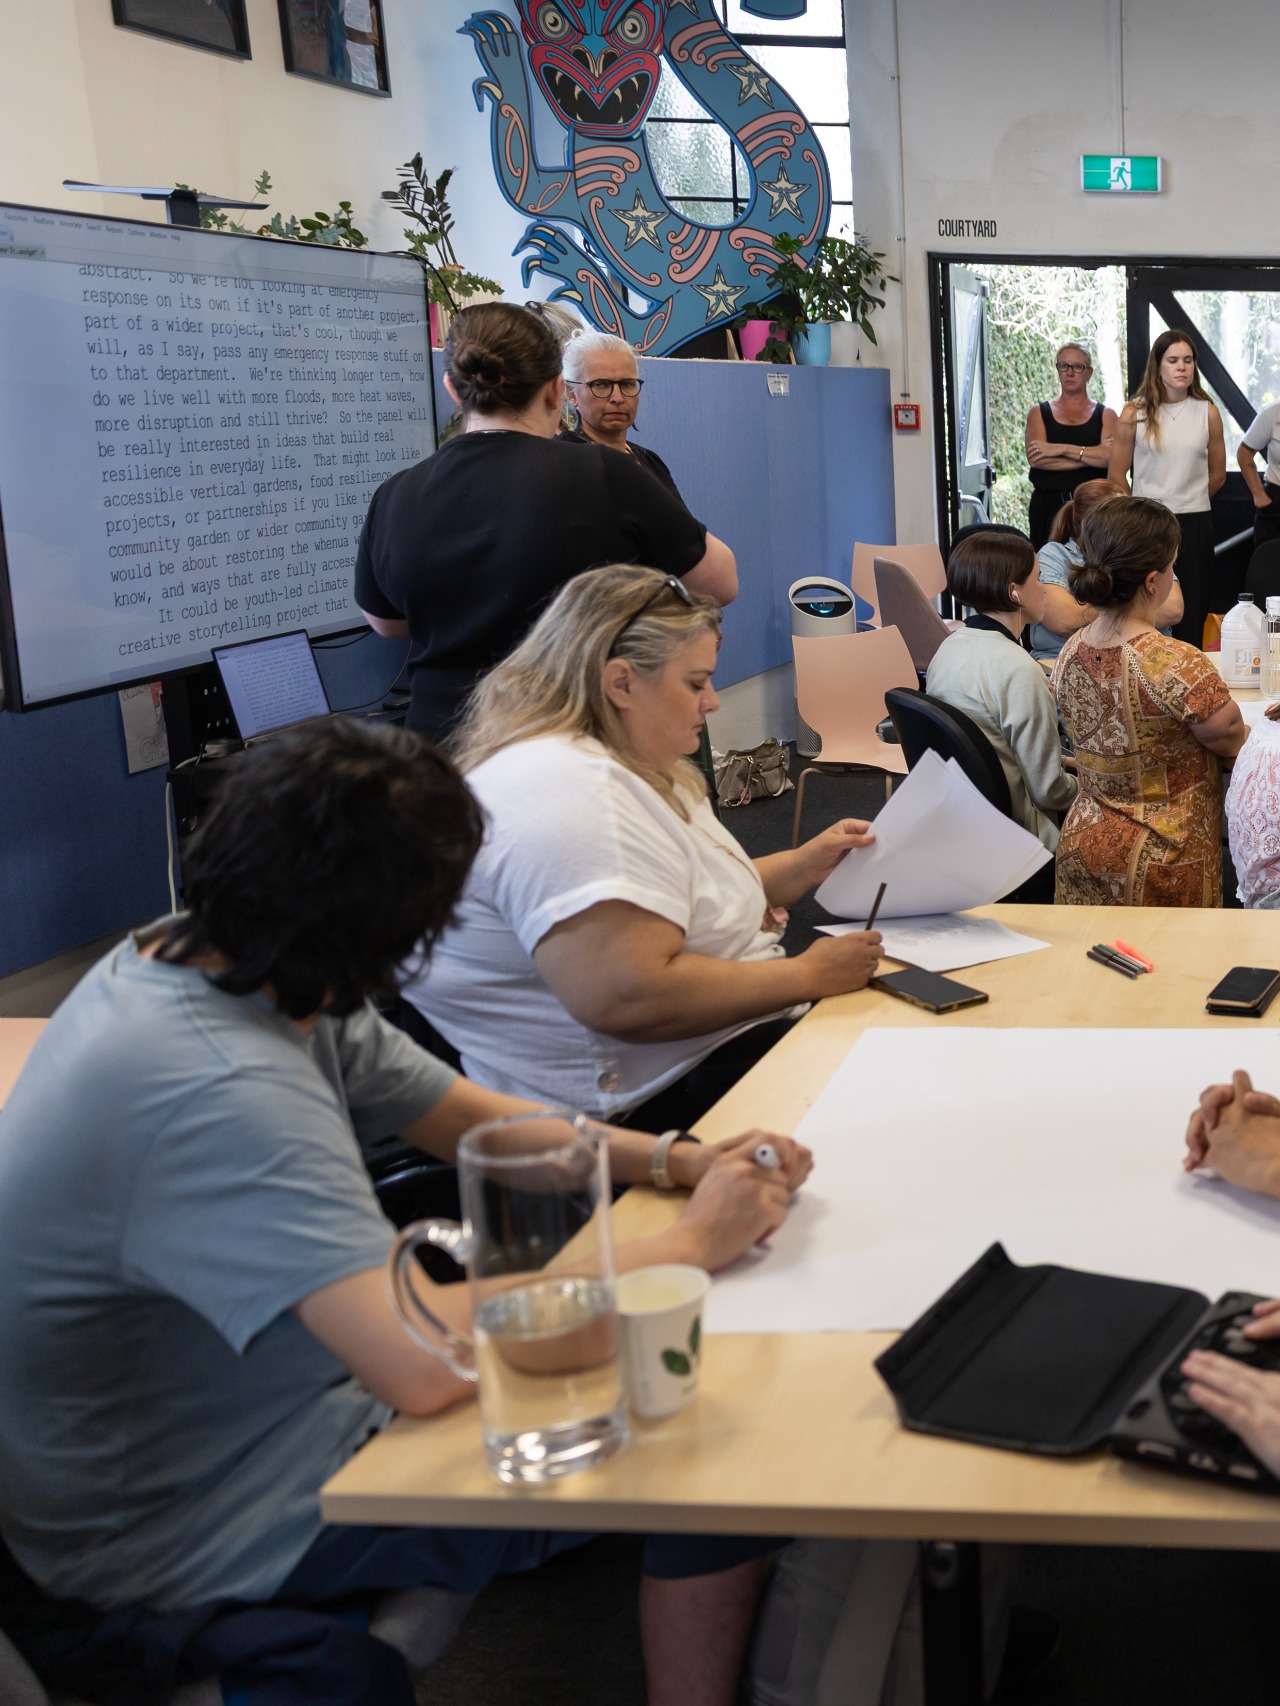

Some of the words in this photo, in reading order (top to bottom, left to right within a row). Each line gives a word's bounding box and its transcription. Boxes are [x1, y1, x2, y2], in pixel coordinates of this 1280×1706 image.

[938, 219, 996, 238] COURTYARD
[82, 290, 148, 307] response
[156, 295, 172, 307] on
[180, 292, 201, 310] its
[208, 298, 230, 311] own
[237, 296, 250, 312] if
[257, 298, 282, 314] it's
[288, 304, 314, 318] part
[318, 304, 330, 318] of
[336, 306, 374, 320] another
[380, 310, 419, 325] project,
[84, 314, 119, 332] part
[126, 314, 142, 330] of
[151, 319, 159, 331] a
[166, 317, 203, 333] wider
[211, 320, 264, 338] project,
[272, 322, 309, 338] that's
[315, 322, 342, 341] cool,
[349, 327, 382, 344] though
[386, 332, 397, 342] we
[87, 338, 127, 358] will,
[138, 343, 154, 356] as
[161, 341, 169, 356] I
[177, 345, 204, 360] say,
[213, 346, 241, 361] pass
[248, 347, 267, 362] any
[274, 348, 328, 363] emergency
[335, 350, 378, 363] response
[383, 349, 408, 362] stuff
[412, 352, 424, 362] on
[90, 365, 108, 380] to
[116, 364, 148, 380] that
[156, 365, 234, 384] department.
[249, 366, 282, 381] We're
[288, 367, 336, 384] thinking
[342, 368, 374, 384] longer
[379, 370, 404, 383] term,
[408, 368, 424, 381] how
[92, 390, 110, 406] do
[118, 394, 135, 406] we
[144, 389, 174, 406] live
[181, 389, 211, 405] well
[218, 389, 246, 404] with
[252, 392, 278, 404] more
[285, 389, 325, 404] floods,
[332, 392, 355, 402] more
[359, 389, 382, 402] heat
[386, 391, 415, 403] waves,
[95, 419, 129, 432] more
[137, 414, 213, 432] disruption
[220, 412, 241, 428] and
[248, 411, 280, 426] still
[286, 410, 328, 425] thrive?
[339, 410, 351, 424] So
[356, 409, 373, 422] the
[377, 408, 403, 425] panel
[407, 408, 427, 420] will
[98, 442, 115, 457] be
[124, 439, 171, 458] really
[180, 435, 250, 452] interested
[257, 434, 270, 449] in
[276, 433, 306, 448] ideas
[312, 432, 336, 446] that
[340, 430, 369, 444] build
[374, 428, 394, 442] real
[102, 464, 181, 482] resilience
[189, 460, 204, 476] in
[210, 453, 264, 476] everyday
[272, 455, 301, 470] life.
[313, 453, 337, 466] That
[342, 450, 370, 467] might
[375, 448, 396, 462] look
[401, 446, 420, 460] like
[104, 487, 183, 507] accessible
[190, 480, 246, 499] vertical
[253, 478, 302, 497] gardens,
[310, 473, 333, 488] food
[106, 514, 175, 536] projects,
[185, 511, 200, 524] or
[207, 500, 287, 525] partnerships
[294, 496, 305, 511] if
[311, 498, 329, 512] you
[335, 492, 357, 506] like
[108, 536, 180, 558] community
[187, 530, 230, 551] garden
[236, 529, 250, 541] or
[256, 522, 288, 538] wider
[294, 515, 347, 533] community
[110, 562, 152, 582] would
[158, 560, 174, 575] be
[182, 554, 218, 572] about
[226, 545, 284, 565] restoring
[290, 541, 309, 555] the
[314, 537, 349, 550] whenua
[114, 592, 151, 608] know,
[162, 581, 184, 599] and
[191, 579, 220, 595] ways
[227, 572, 254, 587] that
[260, 569, 280, 582] are
[286, 561, 316, 577] fully
[158, 608, 173, 624] It
[181, 599, 216, 619] could
[224, 597, 238, 611] be
[244, 584, 302, 610] youth-led
[308, 578, 348, 594] climate
[118, 632, 181, 655] creative
[189, 614, 270, 641] storytelling
[276, 603, 319, 626] project
[325, 597, 348, 612] that
